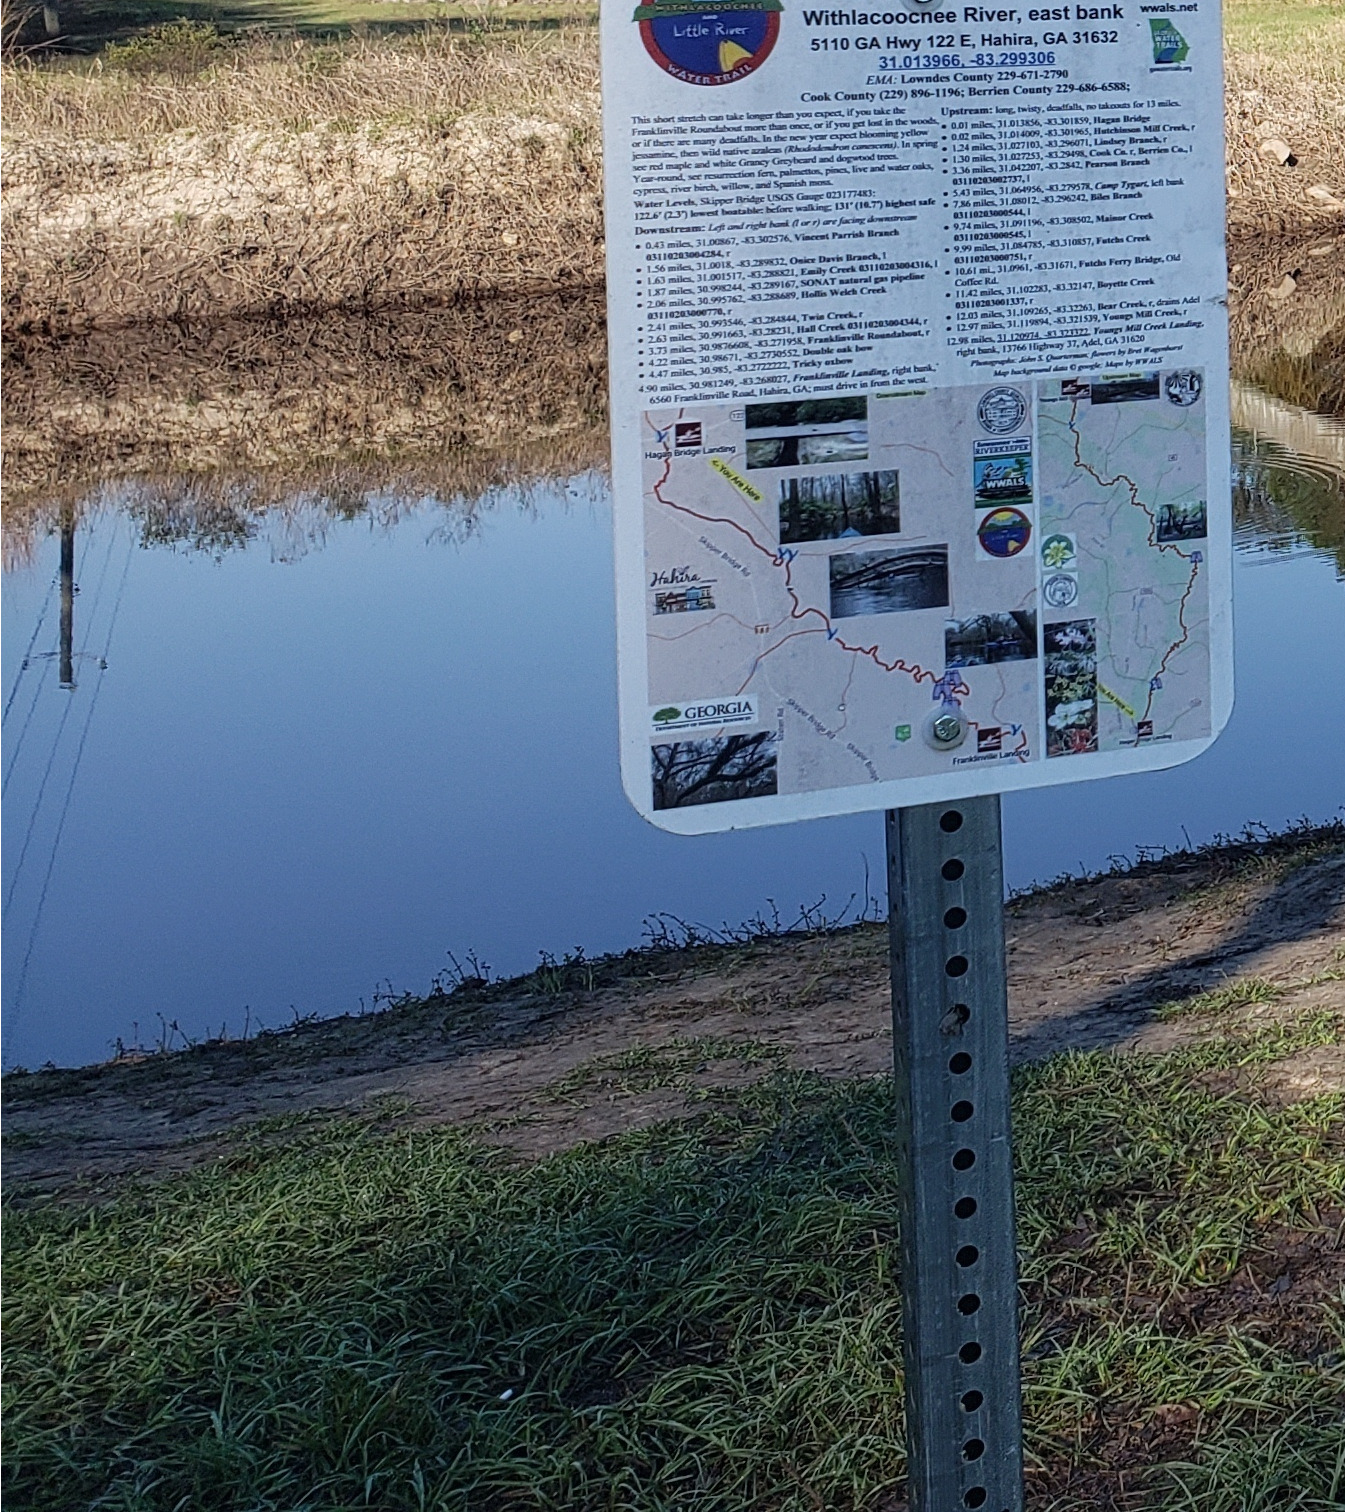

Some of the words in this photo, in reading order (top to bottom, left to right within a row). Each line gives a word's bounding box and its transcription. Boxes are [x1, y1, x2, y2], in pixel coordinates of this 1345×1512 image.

[964, 7, 1021, 23] River,
[1029, 7, 1070, 20] east
[1077, 5, 1123, 19] bank
[1141, 3, 1198, 13] wwals.net
[674, 25, 709, 37] Little
[715, 26, 749, 37] River
[811, 38, 849, 50] 5110
[855, 37, 881, 49] GA
[887, 37, 921, 50] Hwy
[927, 35, 955, 47] 122
[960, 35, 975, 48] E,
[982, 34, 1037, 46] Hahira,
[1043, 32, 1068, 44] GA
[1073, 31, 1117, 43] 31632
[880, 55, 964, 69] 31.013966,
[970, 52, 1055, 67] -83.299306
[667, 64, 711, 84] WATER
[714, 64, 752, 83] TRAIL
[866, 76, 896, 85] EMA:
[902, 74, 950, 83] Lowndes
[954, 73, 993, 83] County
[998, 70, 1068, 80] 229-671-2790
[801, 93, 831, 102] Cook
[835, 92, 875, 101] County
[880, 90, 908, 100] (229)
[911, 88, 964, 98] 896-1196;
[969, 87, 1009, 96] Berrien
[1013, 86, 1052, 95] County
[1056, 83, 1129, 93] 229-686-6588;
[941, 108, 992, 116] Upstream:
[996, 106, 1015, 114] long,
[1018, 105, 1044, 114] twisty,
[645, 448, 672, 459] Hagan
[674, 446, 701, 457] Bridge
[703, 446, 736, 454] Landing
[718, 464, 735, 481] You
[734, 477, 745, 490] Are
[742, 486, 760, 501] Here
[986, 477, 1024, 488] WWALS
[699, 536, 723, 557] Skipper
[721, 551, 743, 570] Bridge
[740, 567, 751, 577] Rd
[651, 567, 701, 586] Hahira
[685, 702, 753, 719] GEORGIA
[786, 699, 809, 719] Skipper
[806, 714, 827, 732] Bridge
[823, 727, 836, 740] Rd
[953, 749, 997, 764] Franklinville
[999, 746, 1029, 760] Landing
